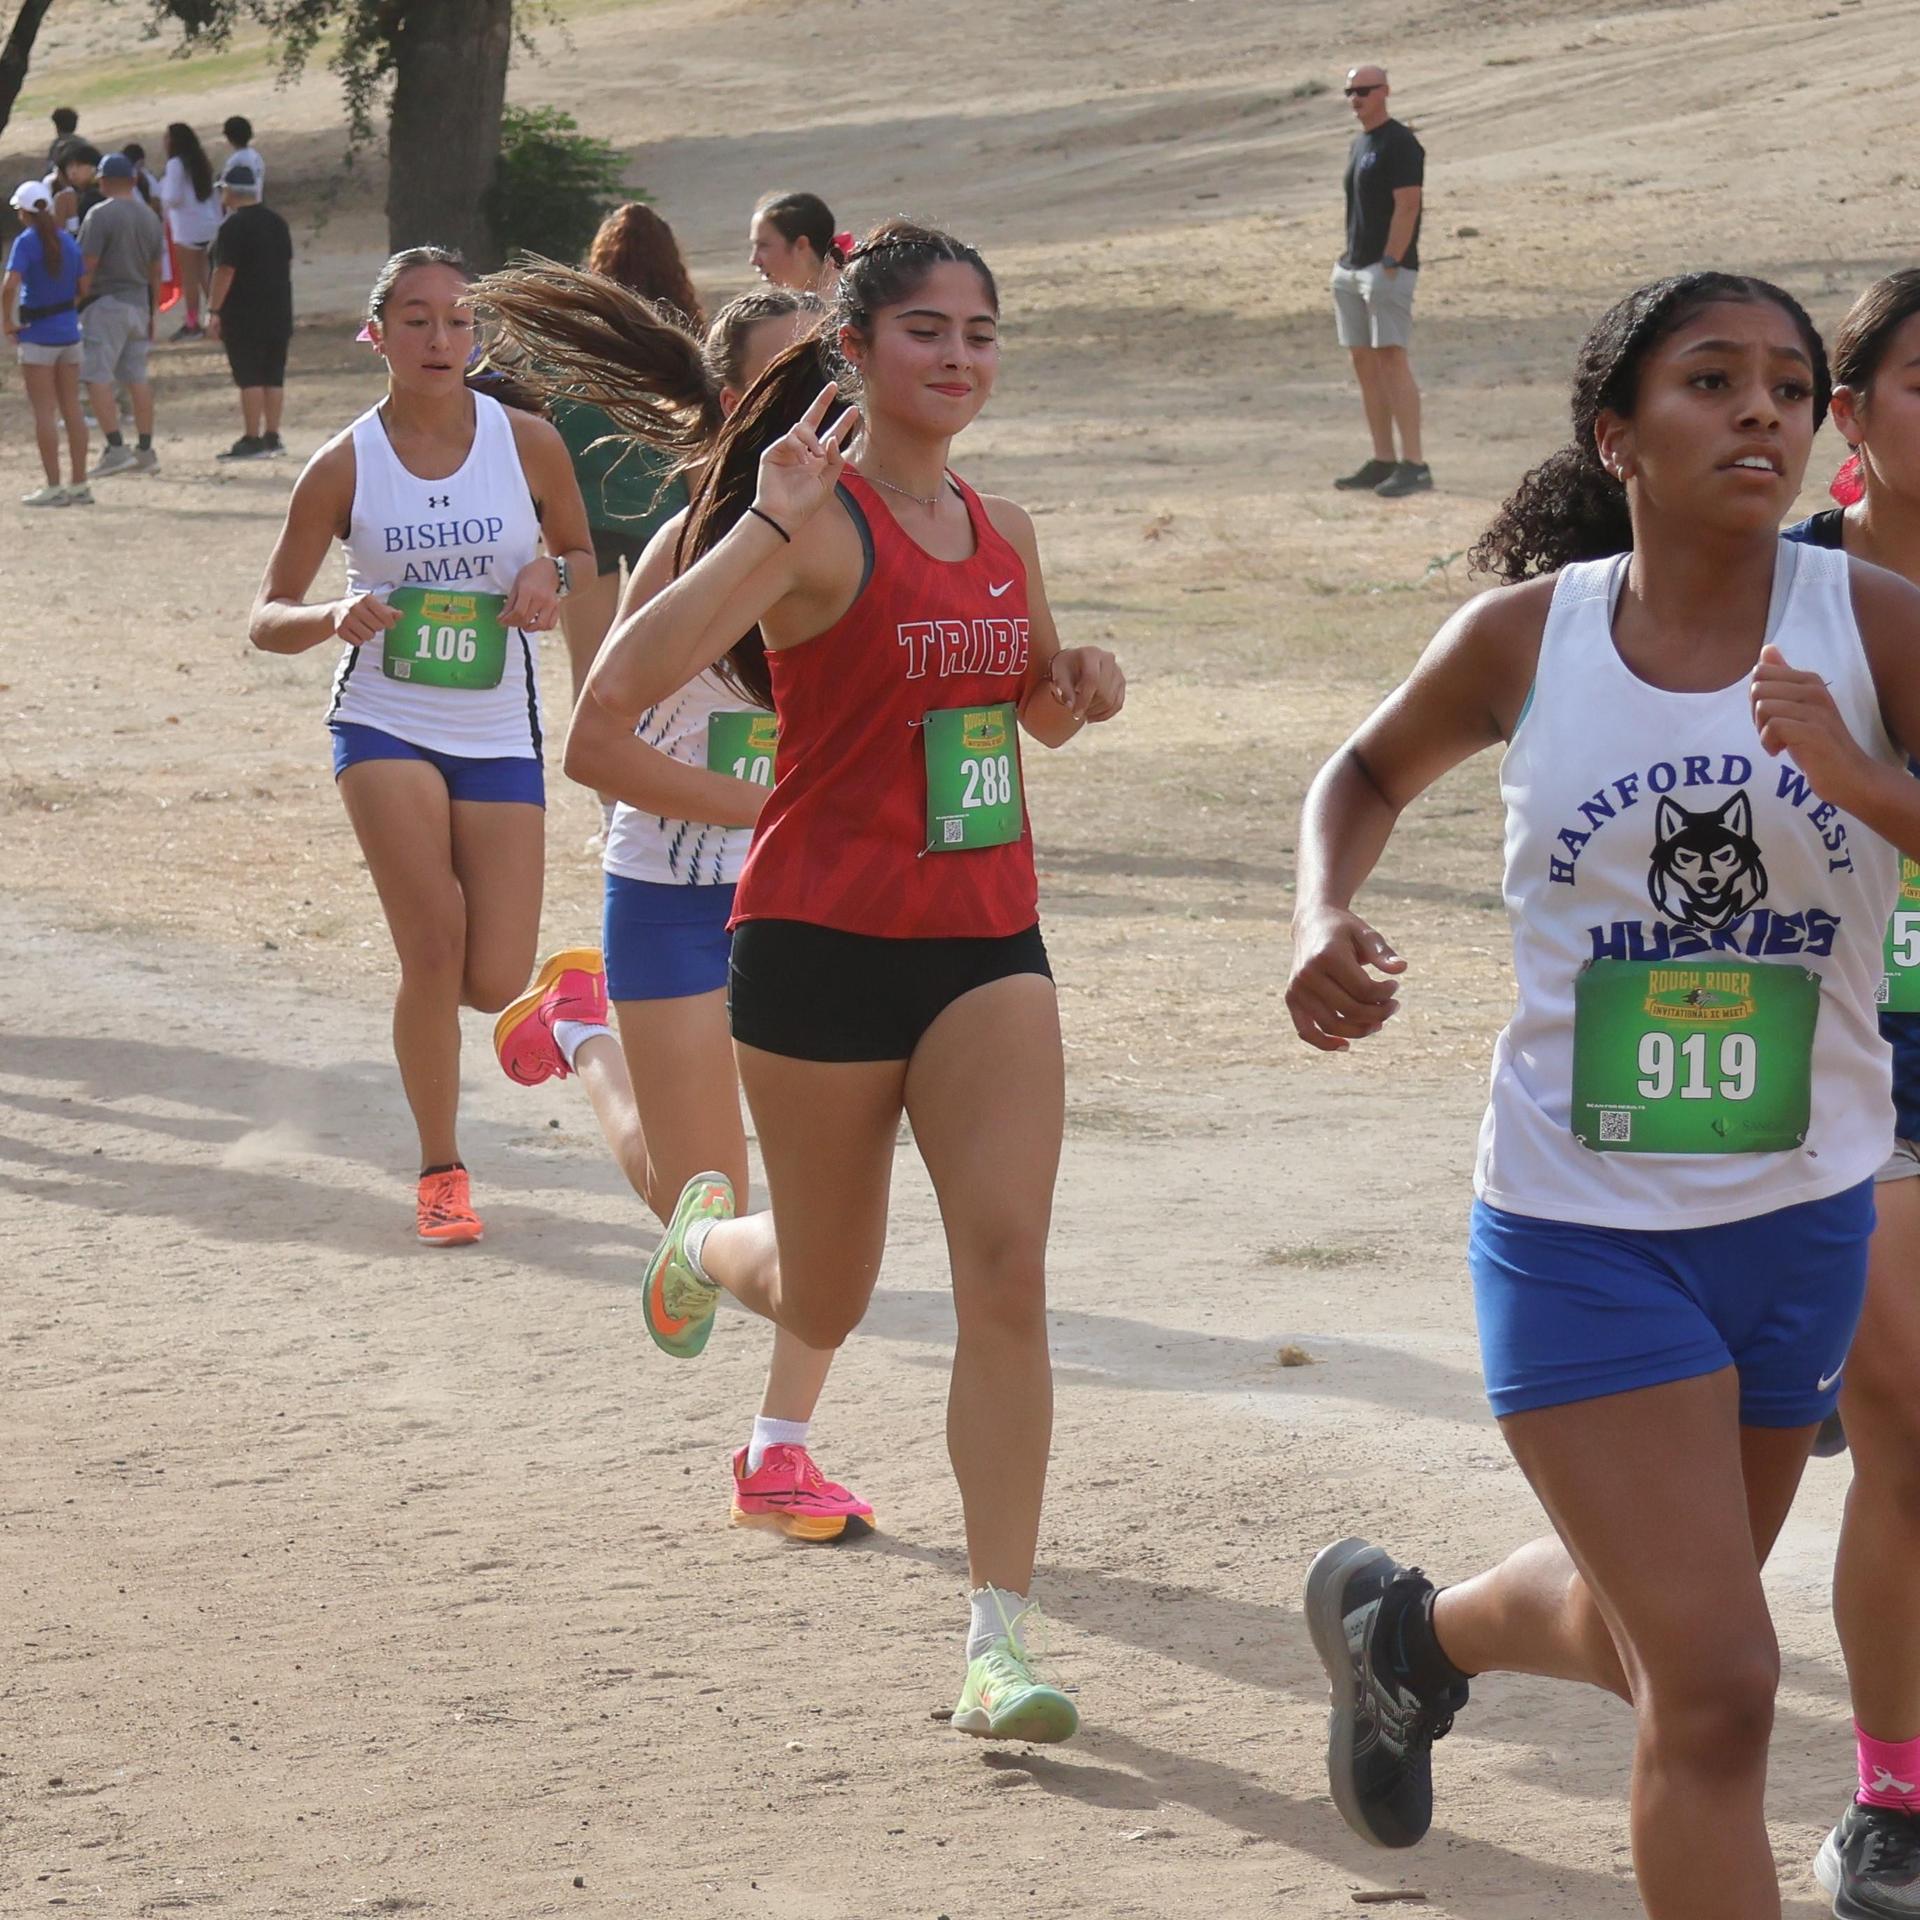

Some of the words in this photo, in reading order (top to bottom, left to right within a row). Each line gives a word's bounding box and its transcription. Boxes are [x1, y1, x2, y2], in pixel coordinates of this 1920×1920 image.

[384, 517, 502, 552] BISHOP
[403, 555, 493, 582] AMAT
[415, 624, 477, 662] 106
[897, 618, 1029, 679] TRIBE
[732, 756, 777, 790] 10
[960, 755, 1011, 808] 288
[1549, 753, 1752, 886] HANFORD
[1776, 764, 1854, 874] WEST
[1587, 908, 1842, 961] HUSKIES
[1649, 970, 1700, 995] ROUGH
[1706, 971, 1751, 997] RIDER
[1637, 1031, 1758, 1101] 919
